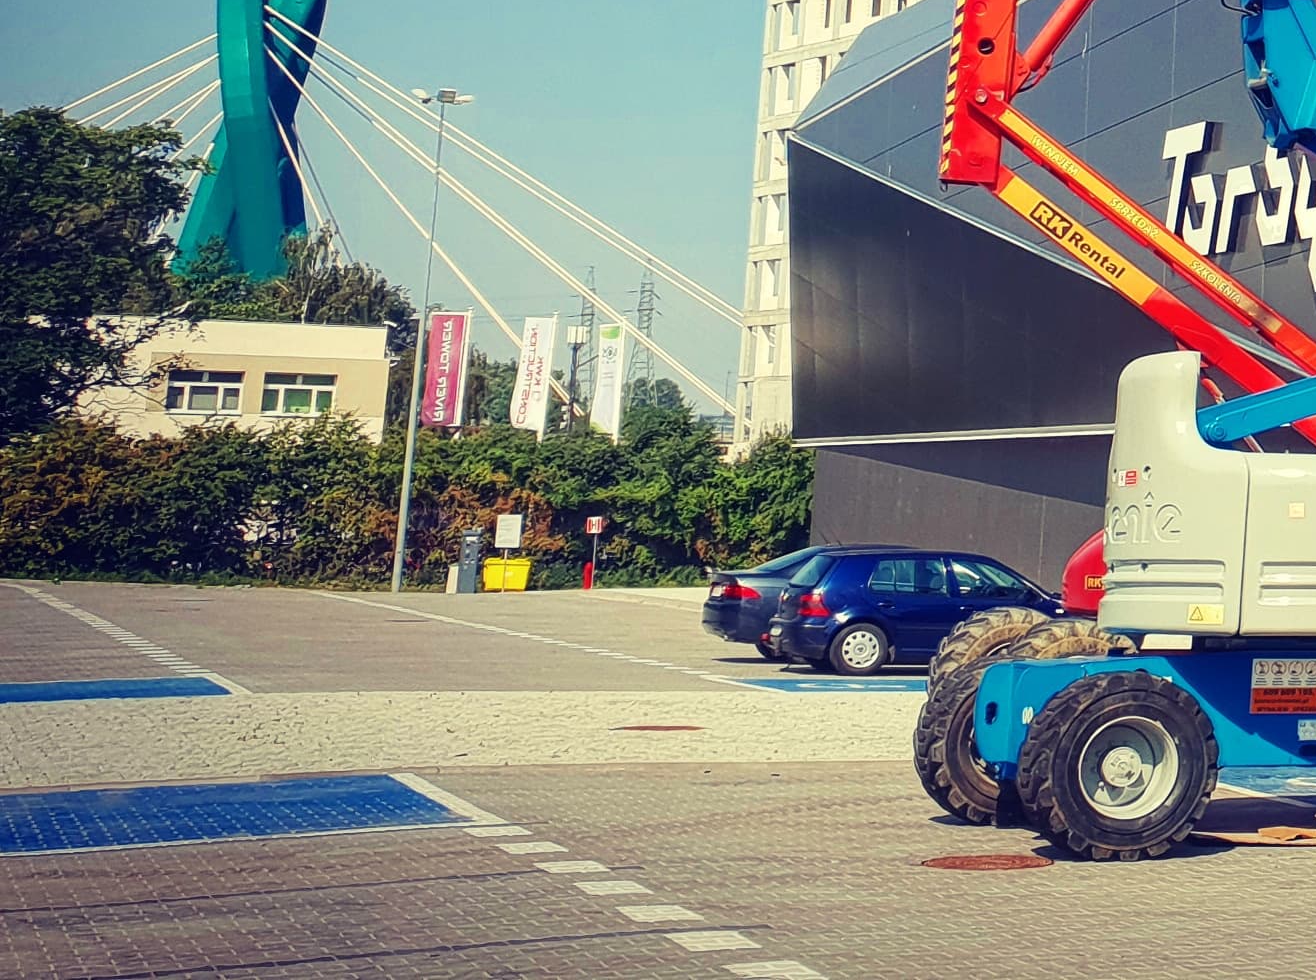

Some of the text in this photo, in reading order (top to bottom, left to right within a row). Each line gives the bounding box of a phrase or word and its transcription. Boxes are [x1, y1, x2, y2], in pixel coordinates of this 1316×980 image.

[1031, 134, 1079, 176] WYNAJEM
[1190, 259, 1242, 305] SZKOLENIA
[1031, 202, 1126, 279] RK Rental
